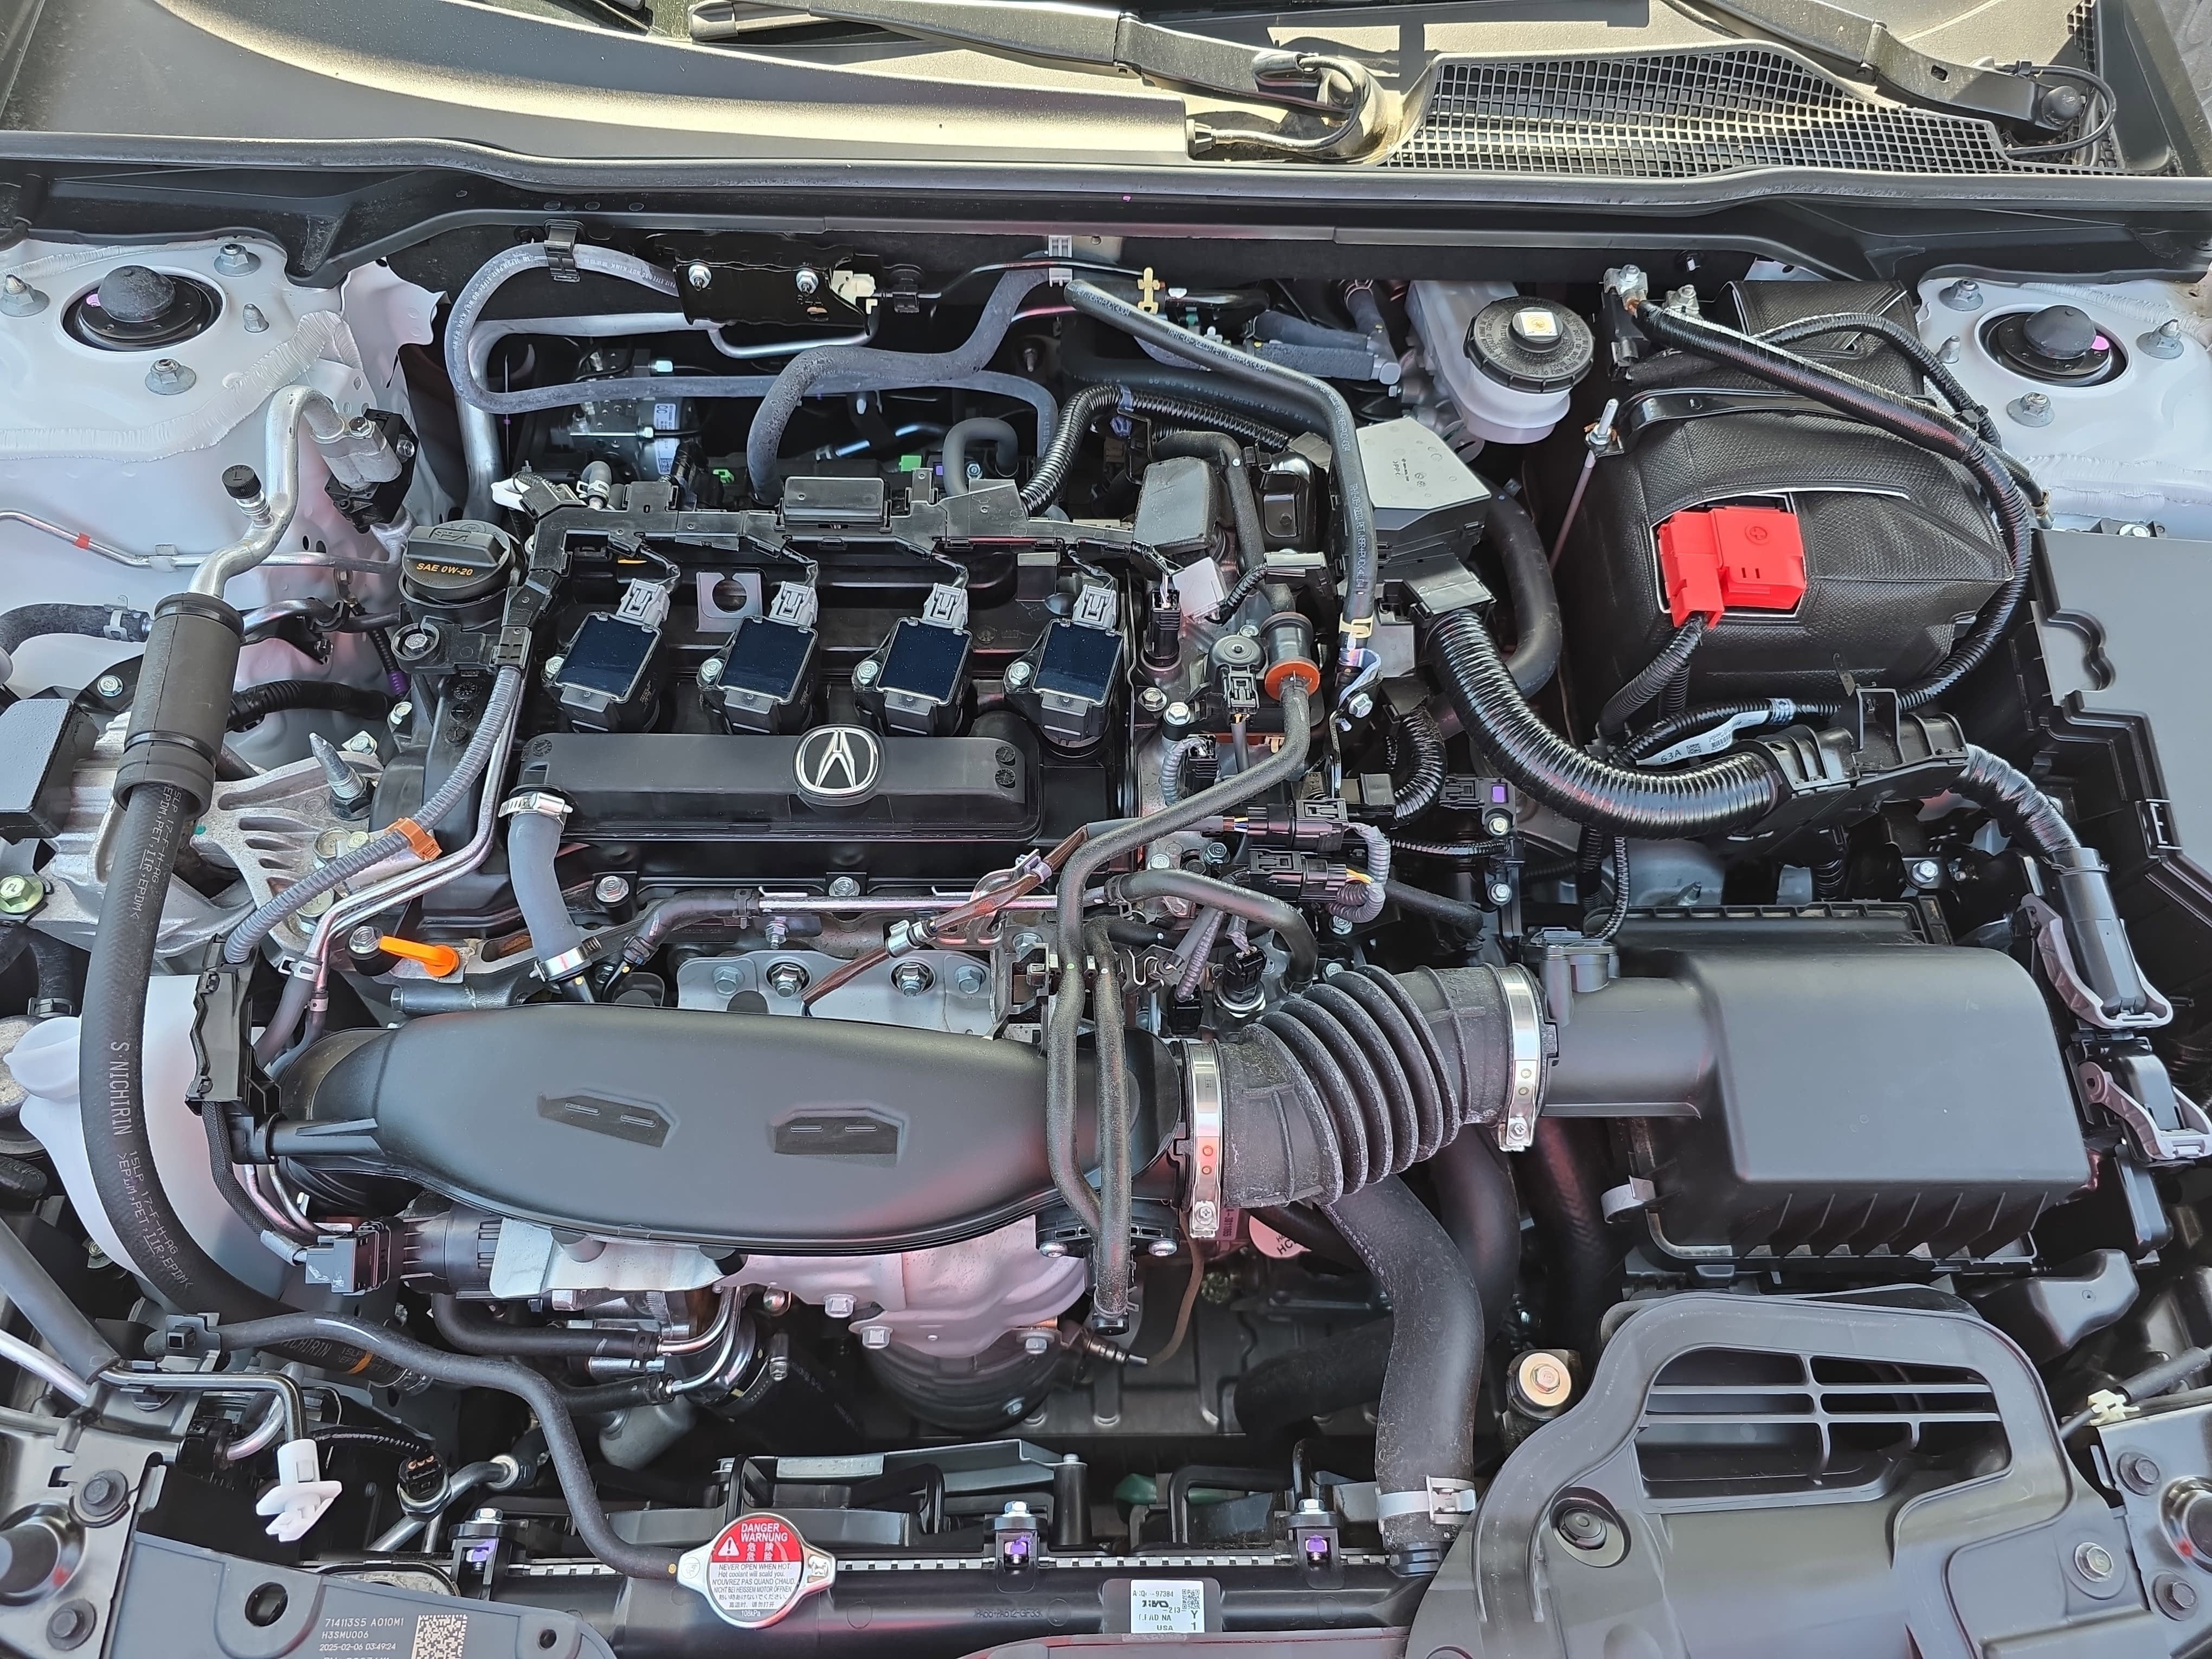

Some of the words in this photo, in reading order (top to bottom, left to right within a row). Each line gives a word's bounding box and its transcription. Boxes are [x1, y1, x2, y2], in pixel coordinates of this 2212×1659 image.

[416, 562, 440, 573] SAE
[440, 565, 473, 576] 0W-20
[1661, 749, 1682, 763] 63A
[130, 785, 173, 920] EPDM,PET,IIR,EPDM<
[741, 1522, 780, 1533] DANGER
[741, 1533, 788, 1542] WARNUNG
[1191, 1610, 1199, 1619] Y
[325, 1617, 367, 1627] 714113S5
[370, 1617, 404, 1627] A010M1
[1191, 1621, 1197, 1631] 1
[321, 1630, 369, 1639] H3SMU006
[319, 1643, 364, 1651] 2025-02-06
[365, 1642, 396, 1651] 03:49:24
